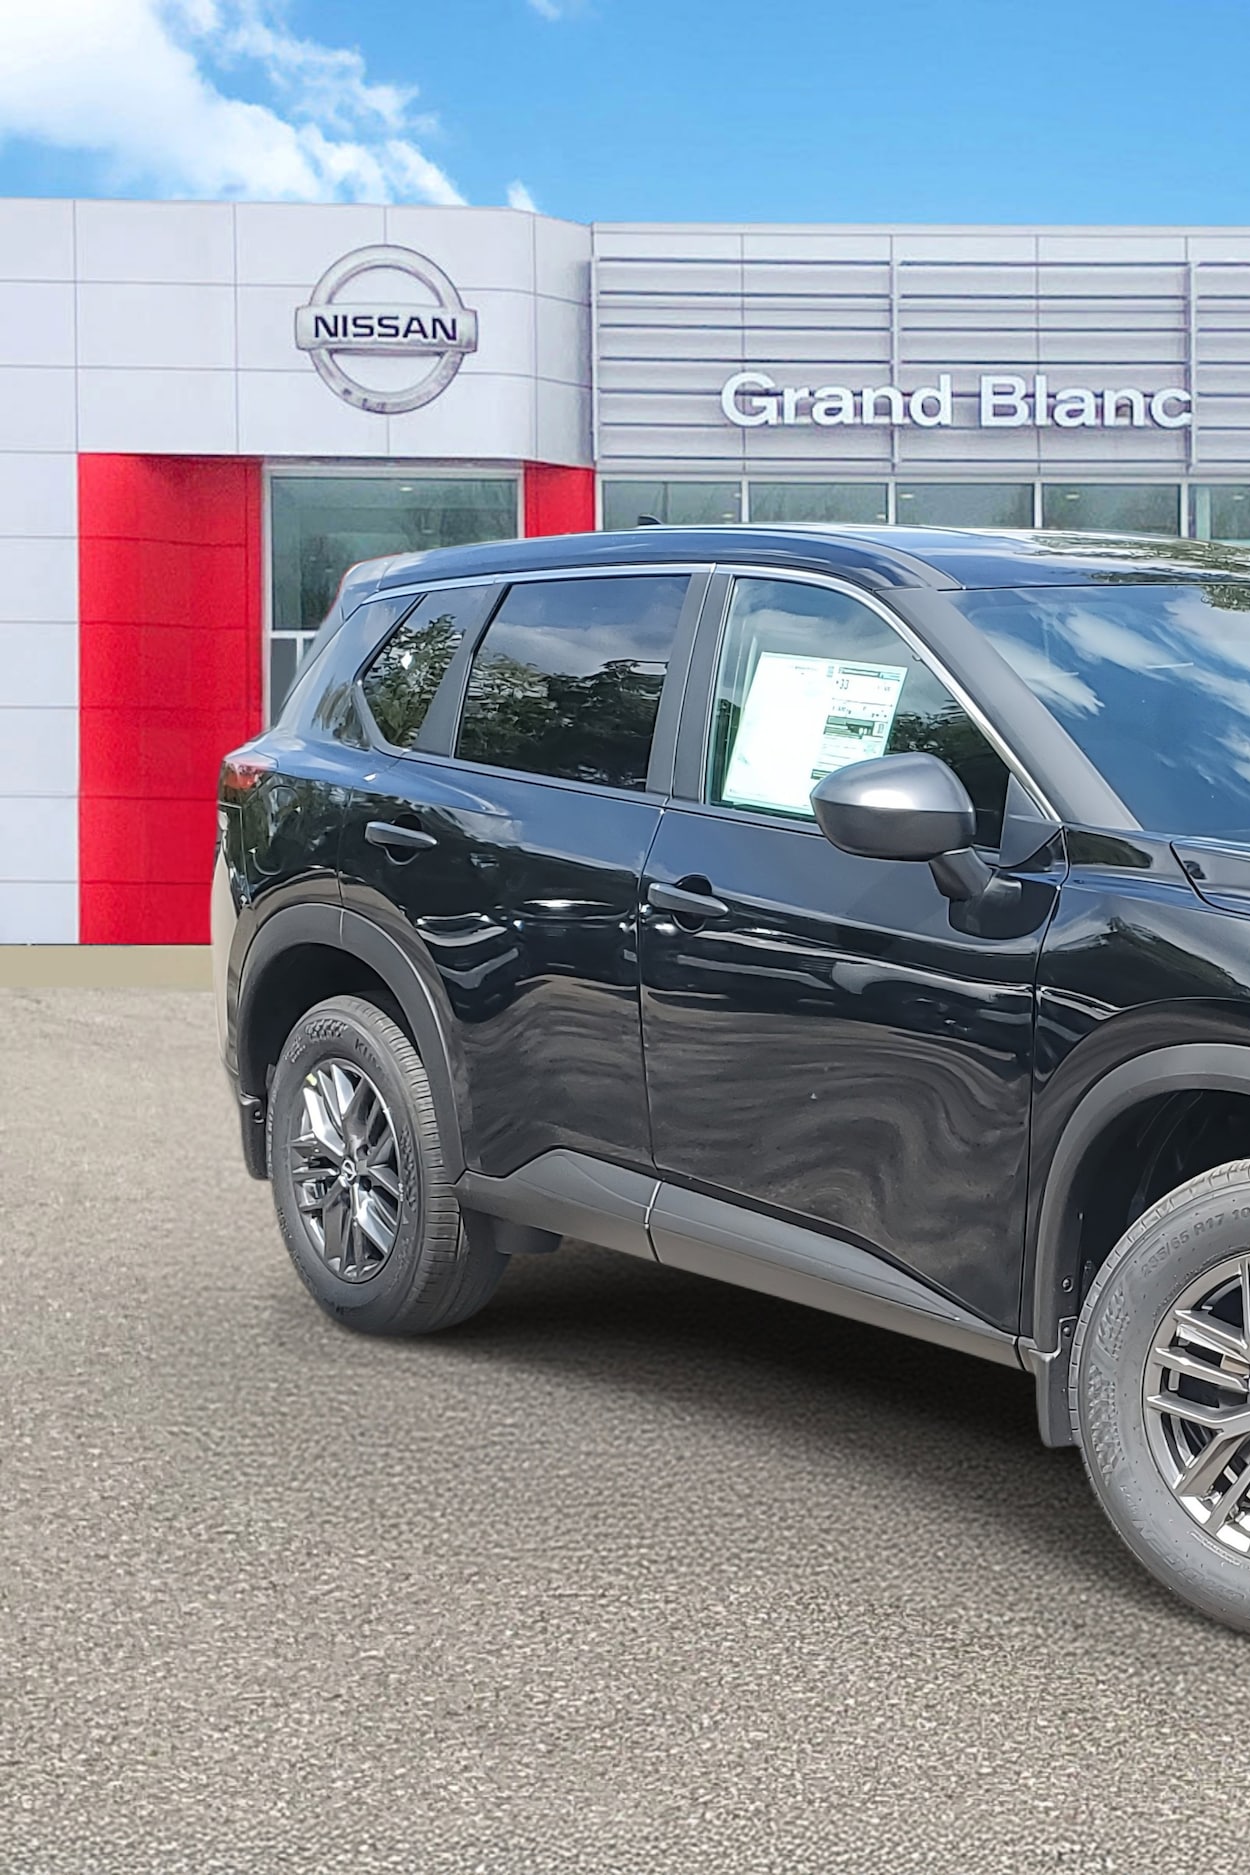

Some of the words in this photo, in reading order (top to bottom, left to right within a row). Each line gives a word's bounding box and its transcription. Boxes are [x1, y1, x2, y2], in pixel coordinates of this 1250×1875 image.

[314, 314, 458, 341] NISSAN
[721, 371, 952, 427] Grand
[980, 374, 1193, 428] Blanc
[1193, 1212, 1225, 1236] R17
